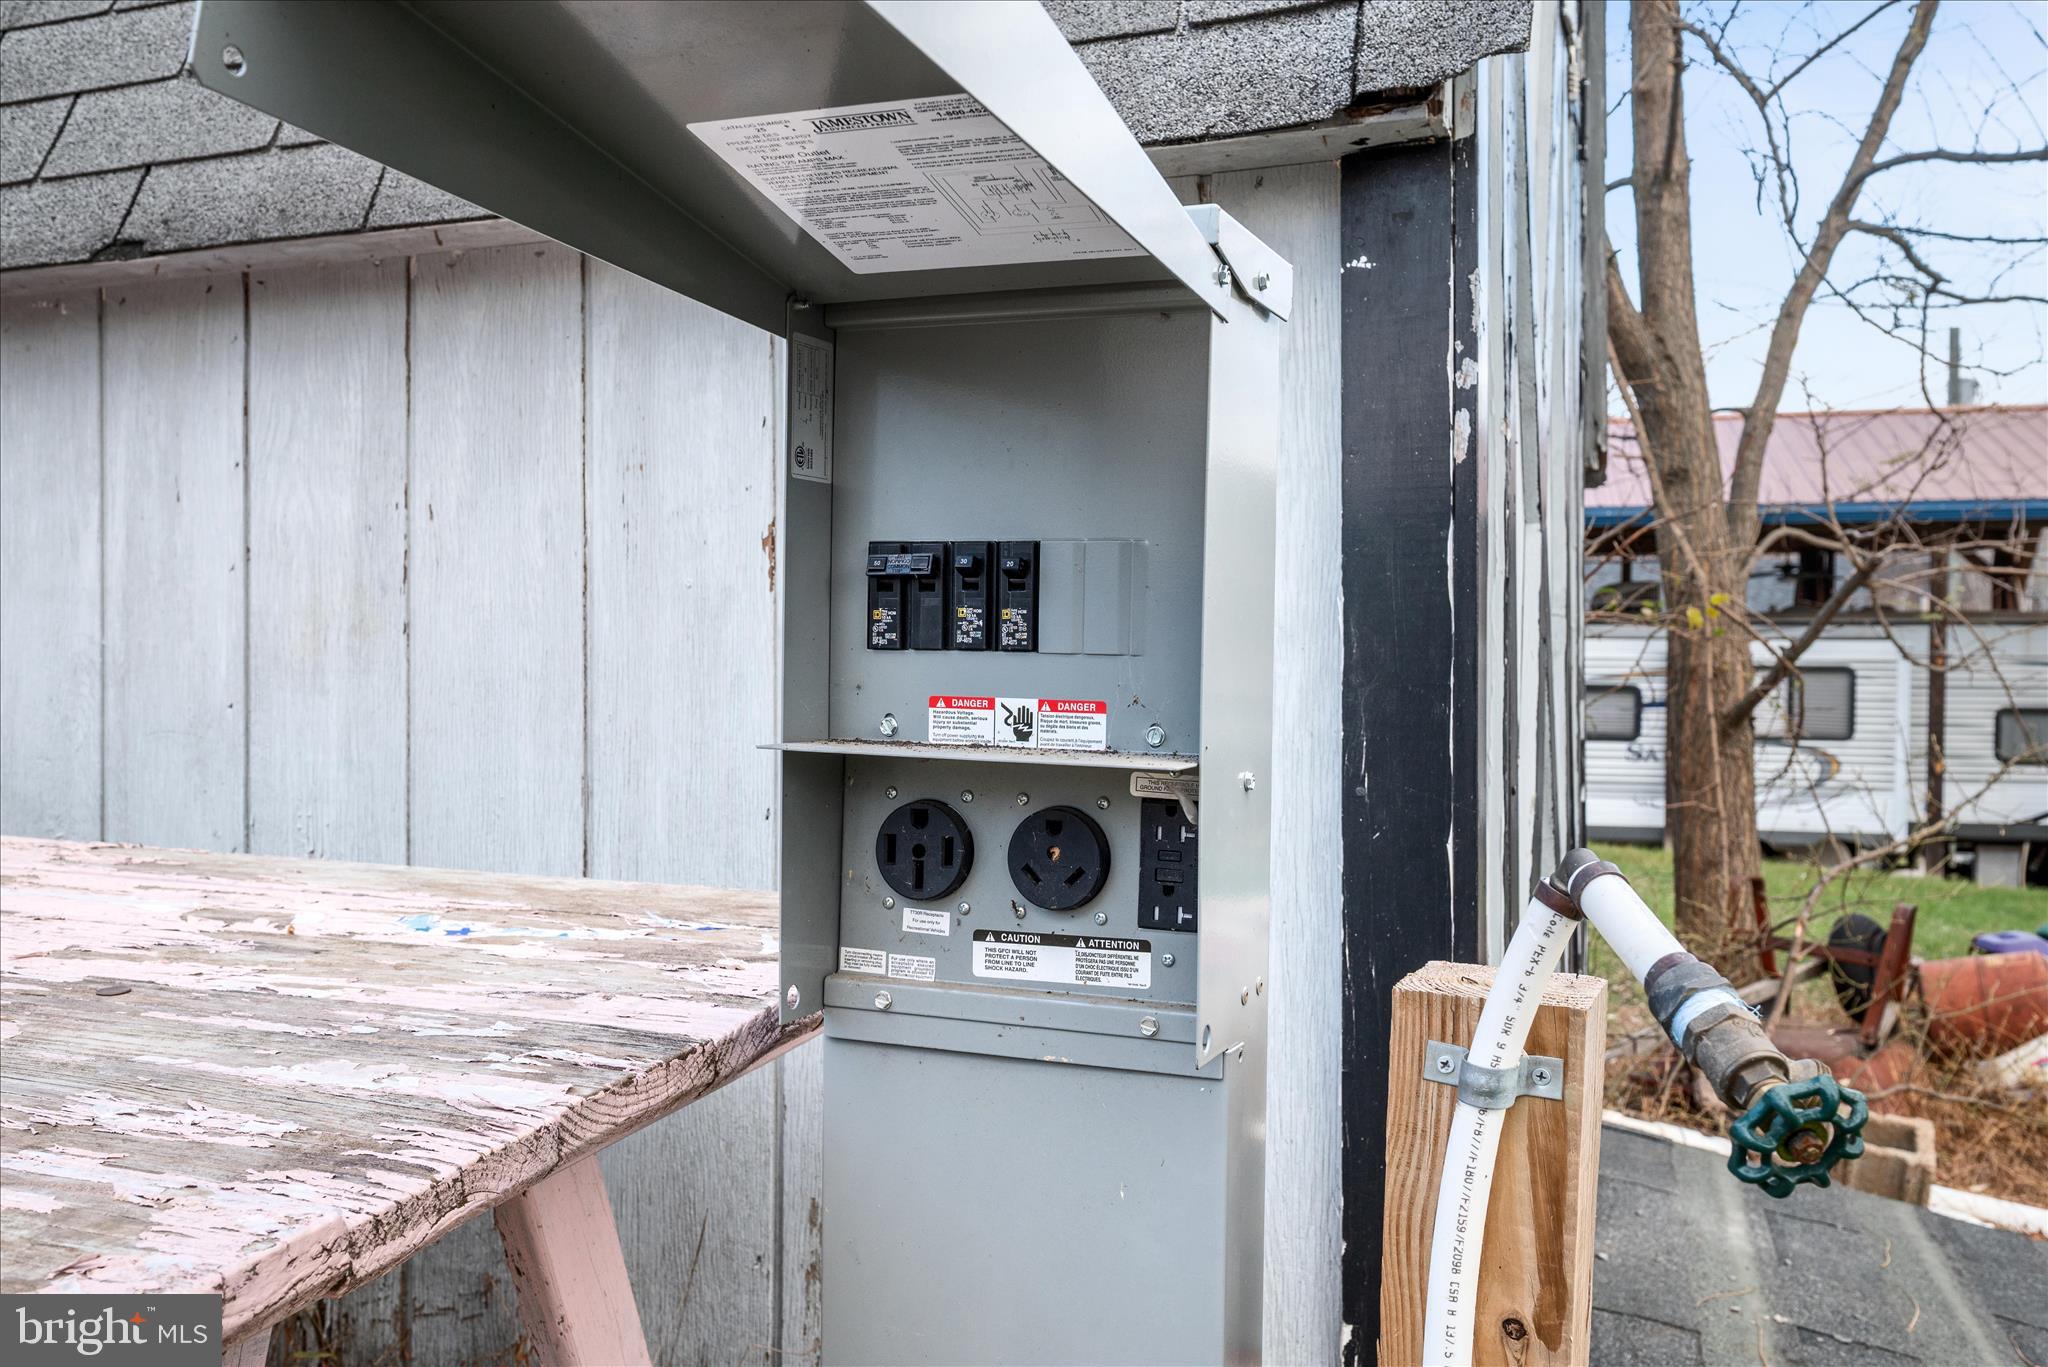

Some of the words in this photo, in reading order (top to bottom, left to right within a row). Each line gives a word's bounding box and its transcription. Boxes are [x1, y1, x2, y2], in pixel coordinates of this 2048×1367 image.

[811, 111, 913, 133] JAMESTOWN
[760, 153, 795, 162] Power
[798, 149, 831, 157] Outlet
[952, 699, 988, 708] DANGER
[1058, 703, 1096, 711] DANGER
[1001, 933, 1040, 944] CAUTION
[1088, 939, 1140, 950] ATTENTION
[1448, 1282, 1460, 1303] CSA
